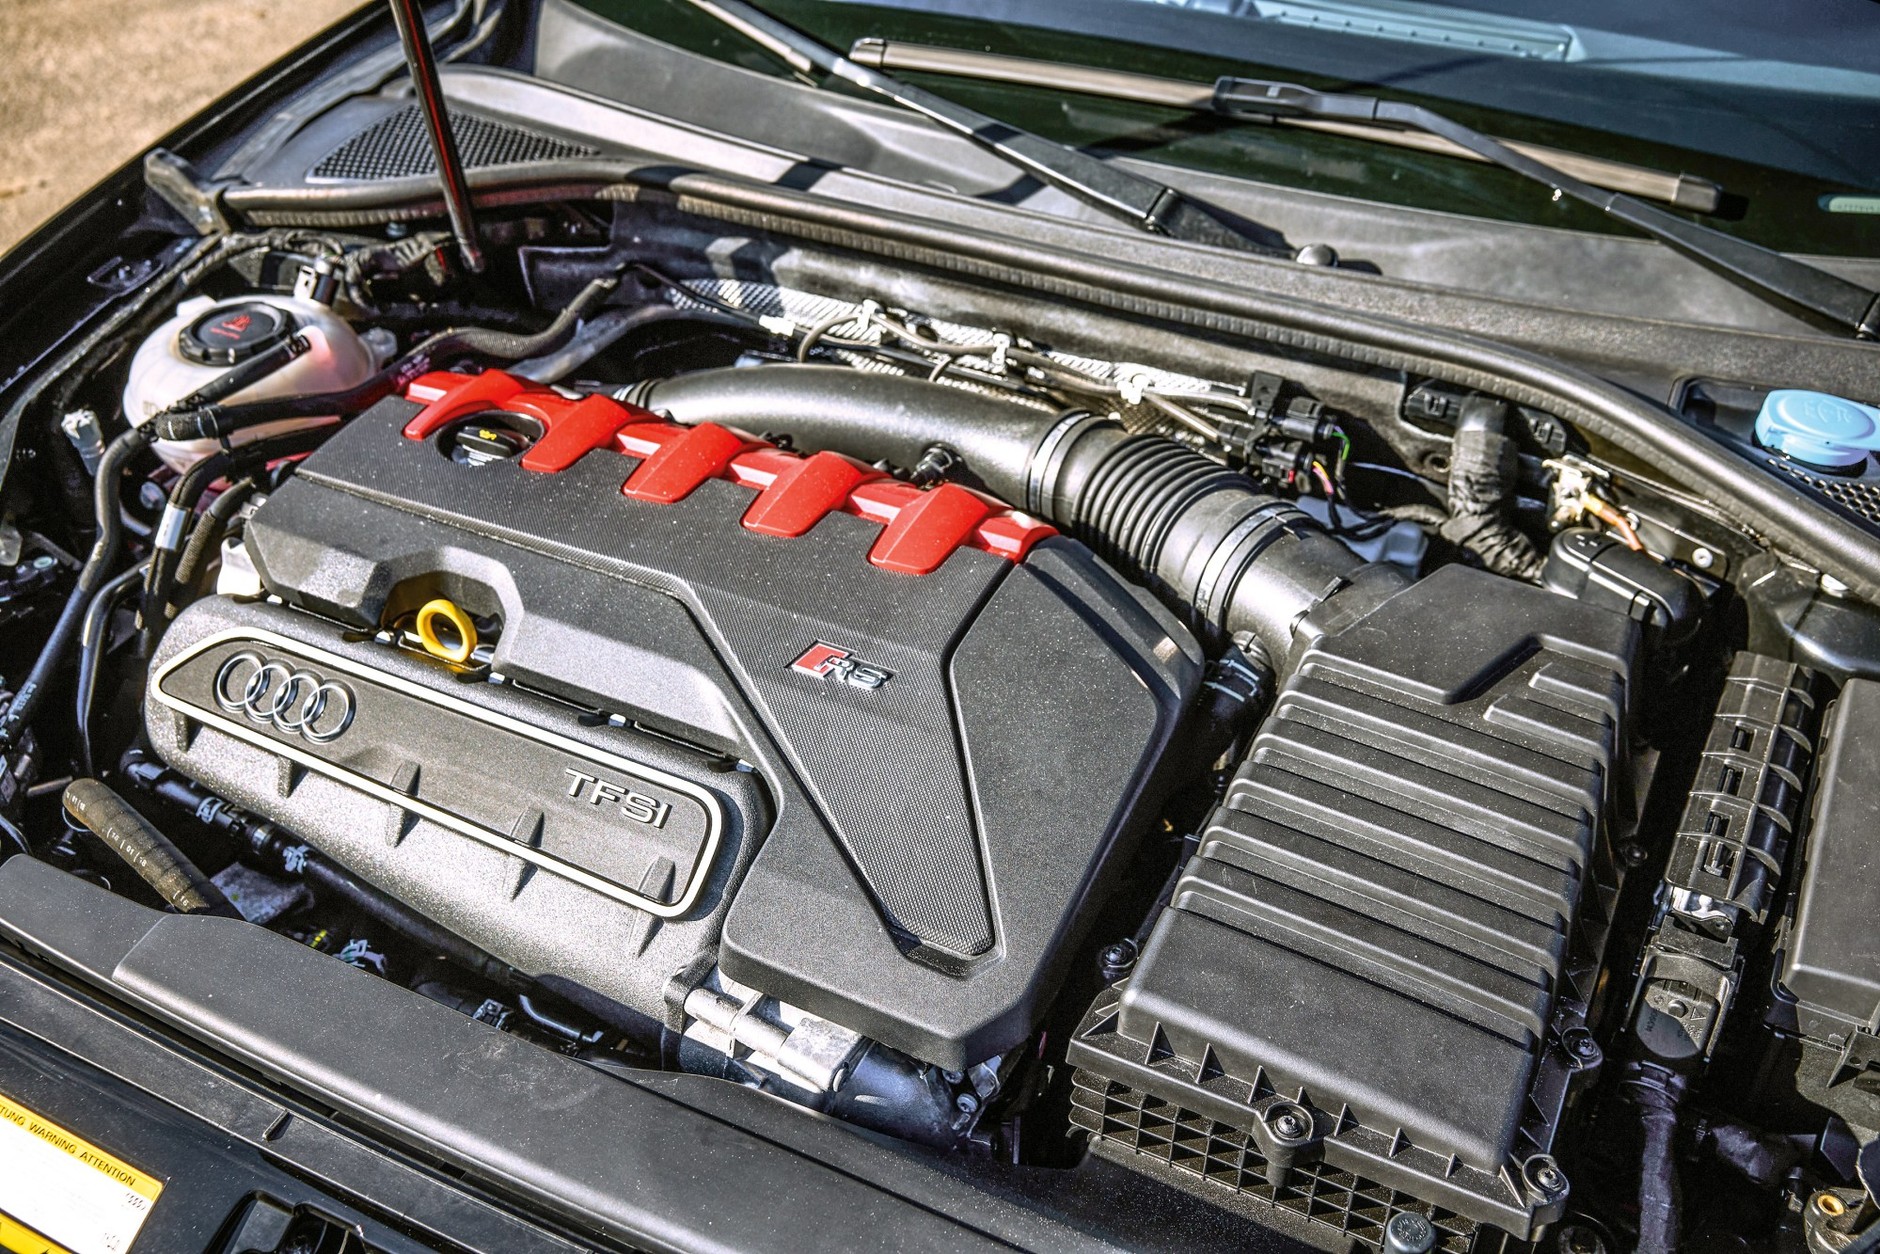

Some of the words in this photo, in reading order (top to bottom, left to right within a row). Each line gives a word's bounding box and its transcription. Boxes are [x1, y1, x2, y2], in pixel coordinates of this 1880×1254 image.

[806, 652, 888, 690] RS
[565, 768, 673, 829] TFSI
[29, 1121, 77, 1155] WARNING
[79, 1151, 137, 1187] ATTENTION
